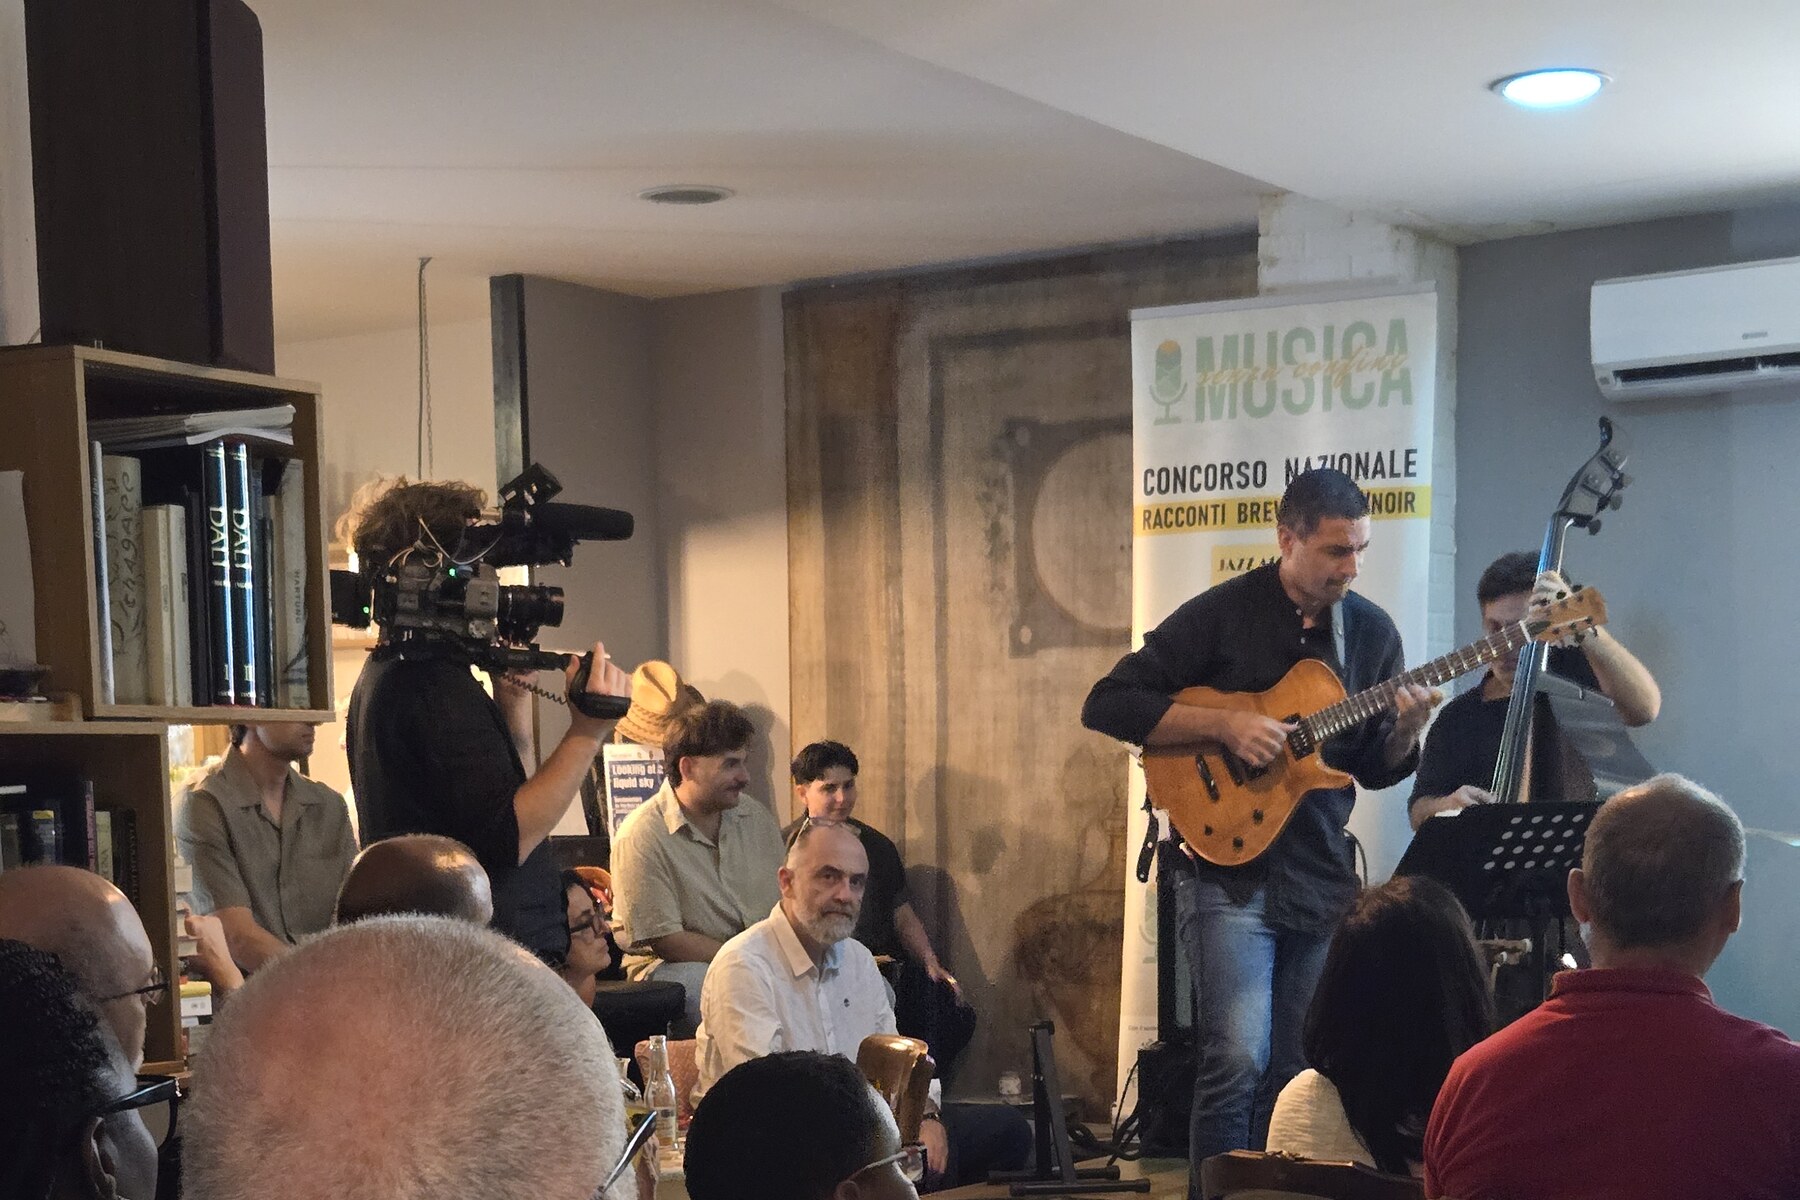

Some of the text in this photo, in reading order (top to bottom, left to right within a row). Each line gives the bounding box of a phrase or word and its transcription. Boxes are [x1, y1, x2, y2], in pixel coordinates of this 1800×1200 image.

[1195, 318, 1413, 424] MUSICA
[1143, 460, 1268, 496] CONCORSO
[1143, 503, 1226, 531] RACCONTI
[612, 763, 645, 776] Looking
[613, 777, 654, 789] liquid sky
